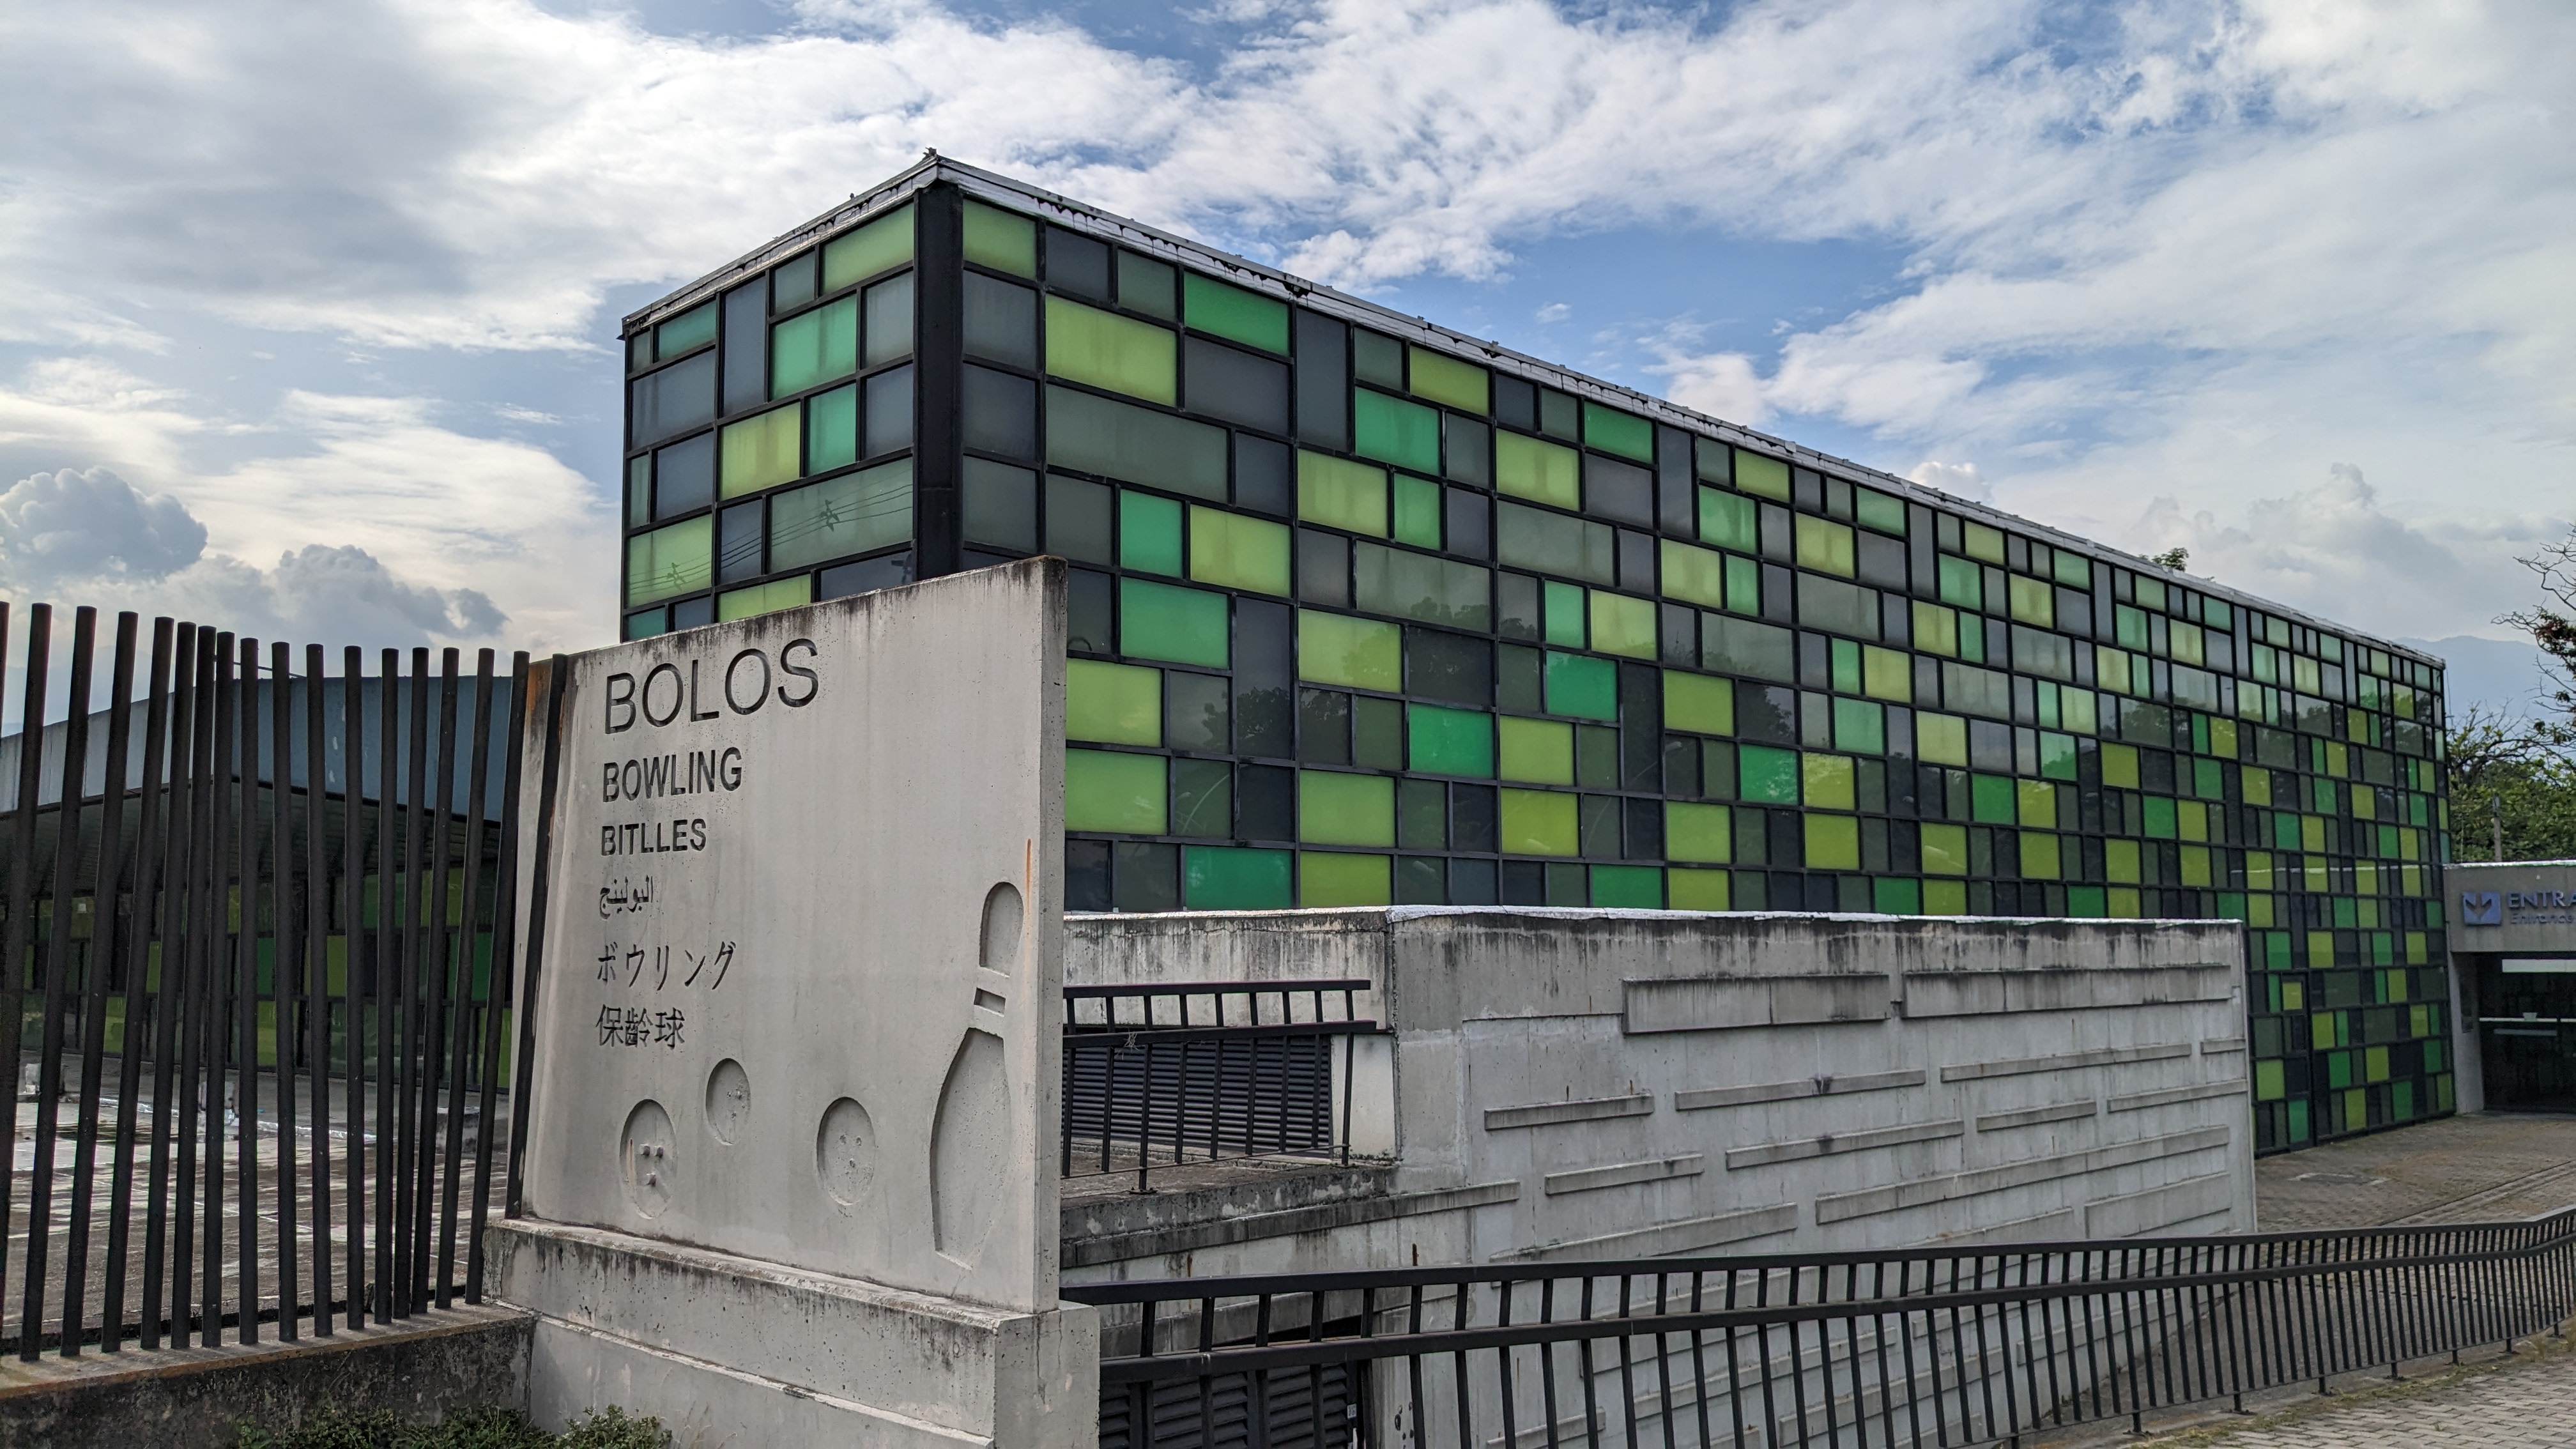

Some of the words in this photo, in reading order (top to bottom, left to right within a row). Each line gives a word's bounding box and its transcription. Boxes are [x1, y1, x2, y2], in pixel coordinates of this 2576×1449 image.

[604, 638, 818, 734] BOLOS
[602, 746, 742, 802] BOWLING
[601, 818, 707, 856] BITLLES
[597, 940, 737, 992] ボウリング
[595, 1004, 686, 1050] 保齡球
